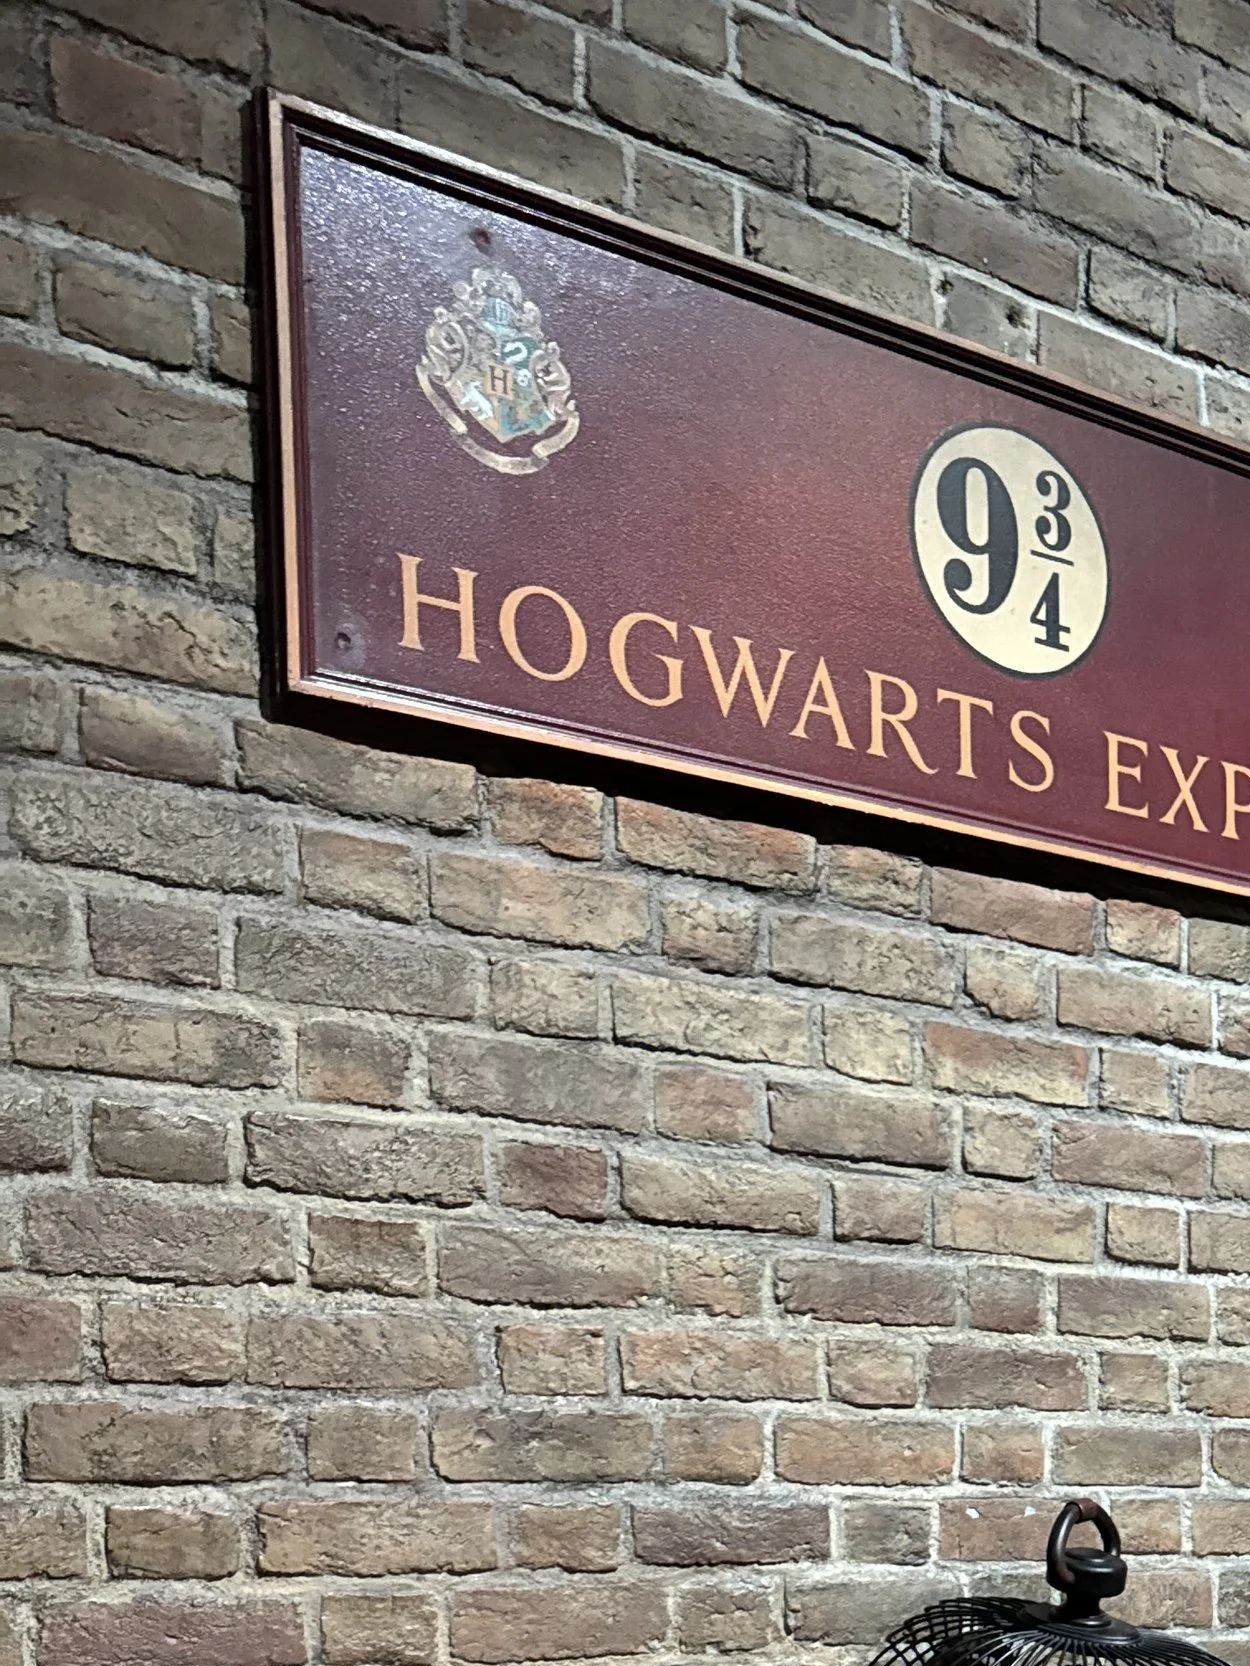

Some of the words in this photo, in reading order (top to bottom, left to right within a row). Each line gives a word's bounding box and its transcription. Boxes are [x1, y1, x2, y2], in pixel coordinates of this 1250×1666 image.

[489, 364, 511, 395] H
[936, 456, 1019, 615] 9
[396, 552, 1055, 793] HOGWARTS
